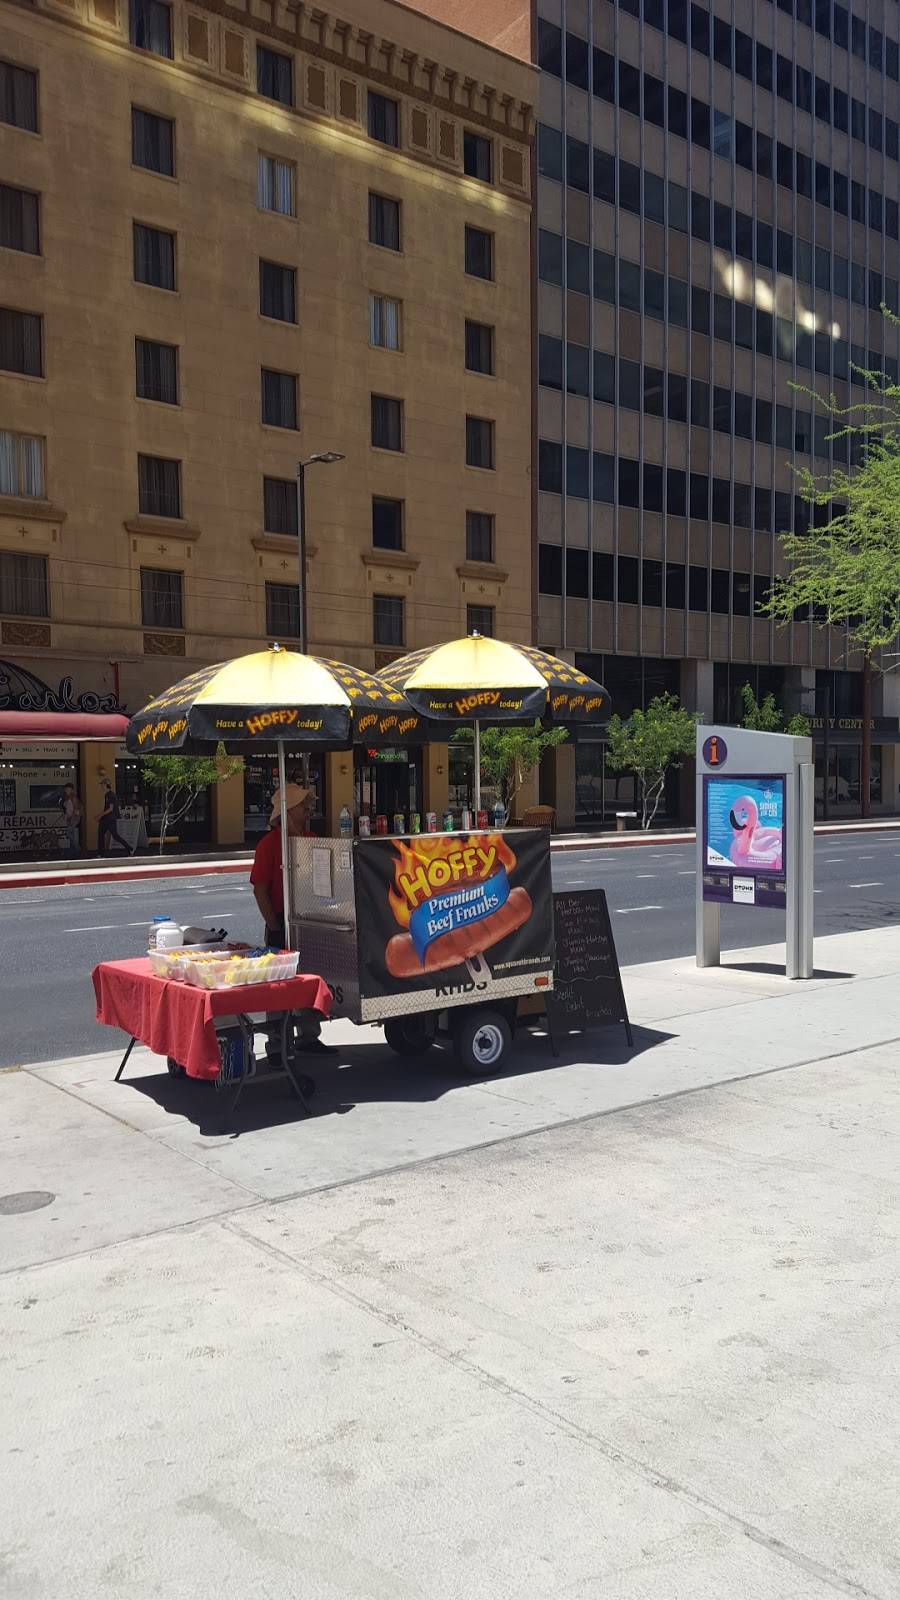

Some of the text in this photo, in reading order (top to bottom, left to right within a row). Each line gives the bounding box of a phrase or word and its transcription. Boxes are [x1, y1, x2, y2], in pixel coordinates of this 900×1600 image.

[429, 700, 447, 709] Have
[455, 691, 501, 714] HOFFY
[499, 700, 523, 710] today!
[552, 694, 602, 713] HOFFY HOFFY HOFFY
[168, 719, 187, 741] HOFFY
[216, 709, 323, 735] Have a HOFFY today!
[358, 713, 418, 735] HOFFY HOFFY HOFFY
[839, 719, 876, 729] CENTR
[10, 770, 70, 778] iPhone iPad
[3, 815, 48, 827] REPAIR
[400, 846, 496, 907] HOFFY
[428, 885, 485, 915] Premium
[427, 893, 499, 937] Beef Franks
